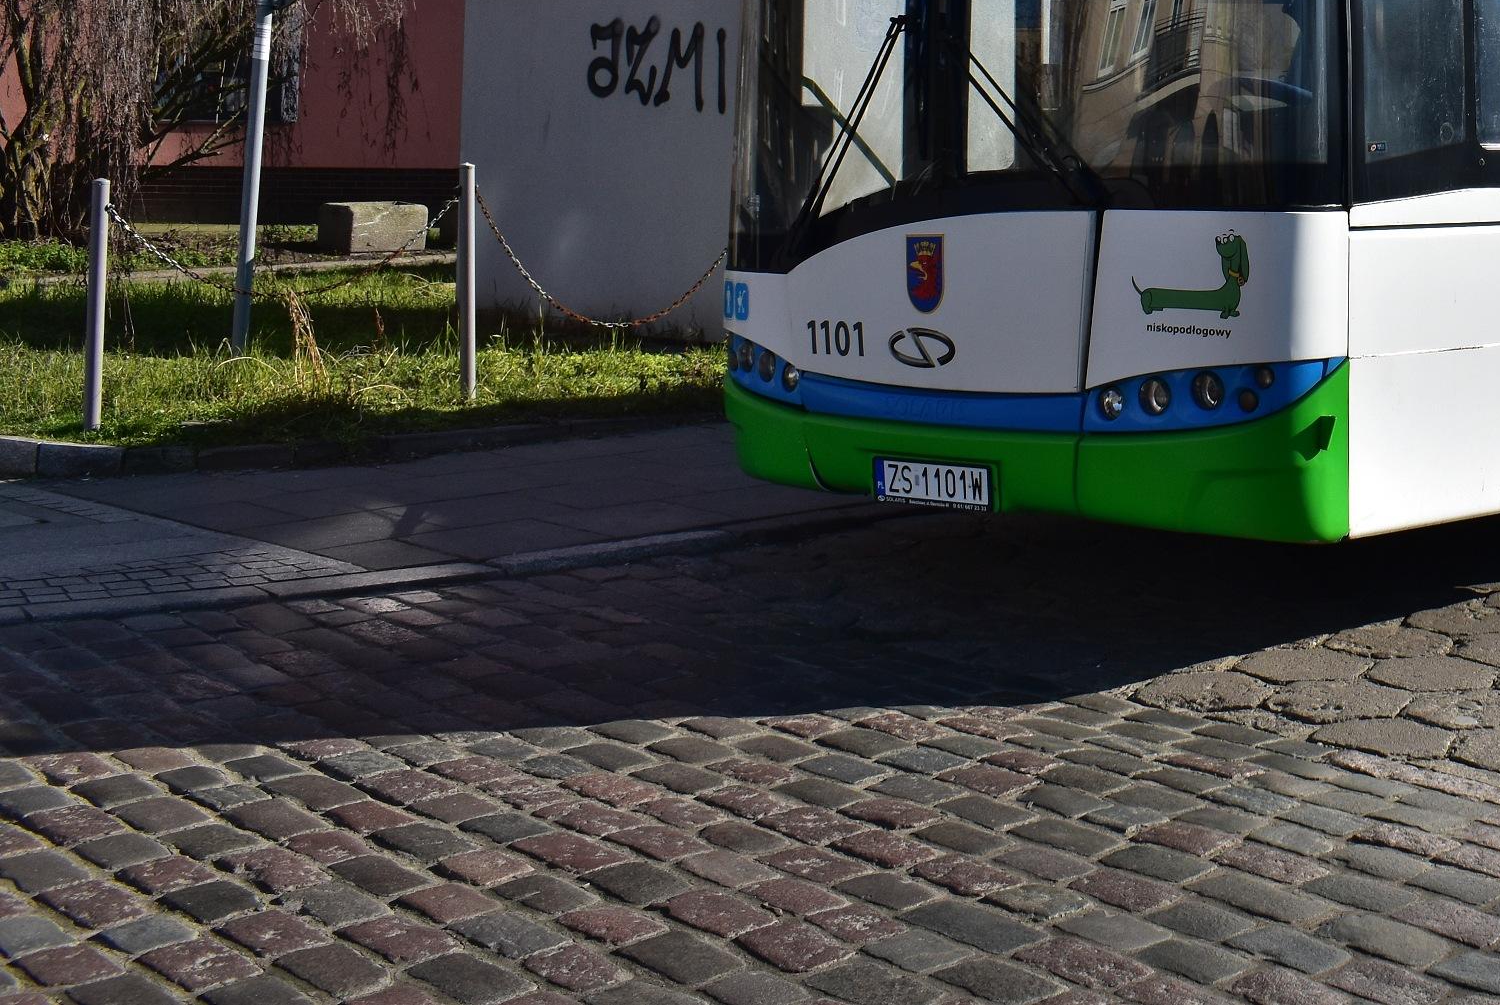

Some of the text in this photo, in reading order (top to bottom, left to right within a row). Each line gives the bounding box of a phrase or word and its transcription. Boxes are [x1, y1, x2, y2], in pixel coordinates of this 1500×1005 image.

[806, 319, 865, 358] 1101
[1146, 322, 1232, 339] niskopodłogowy
[887, 463, 983, 502] ZS 1101W
